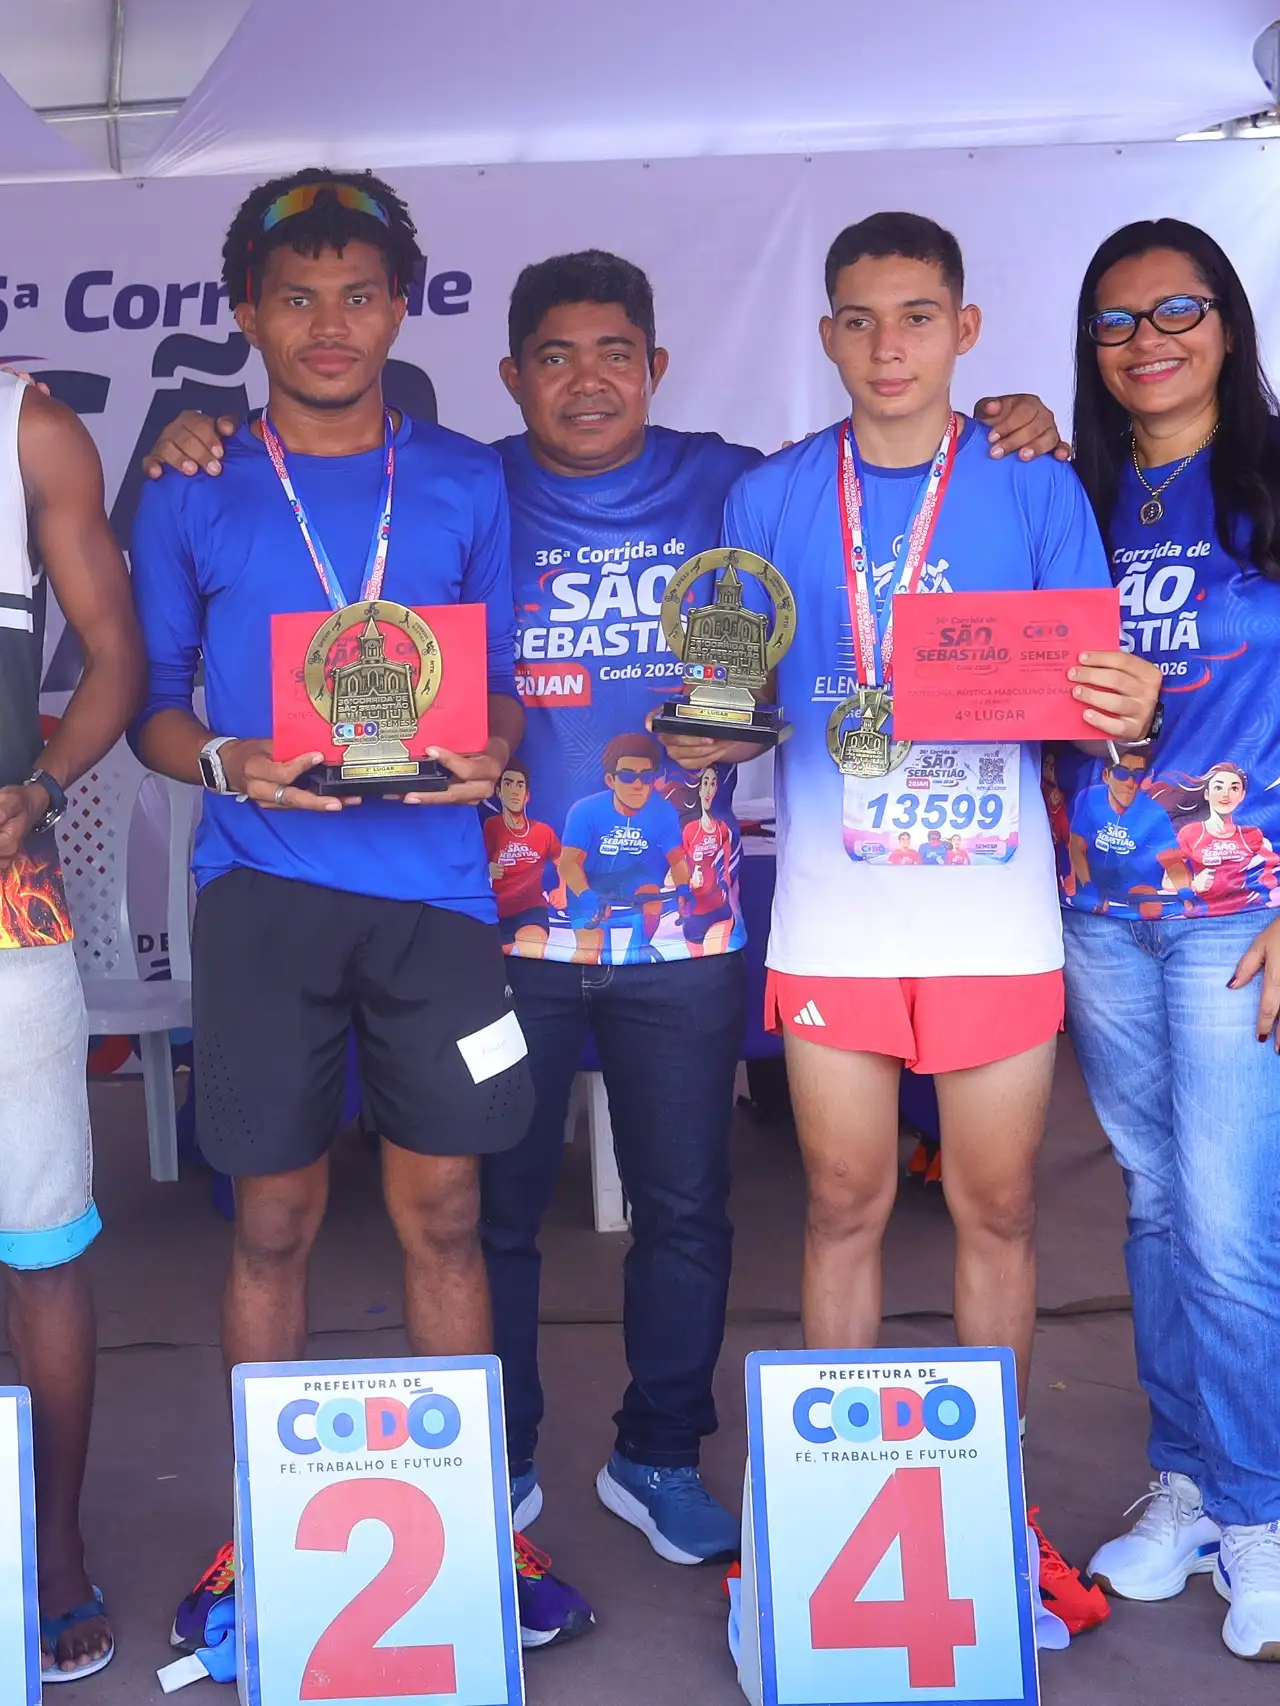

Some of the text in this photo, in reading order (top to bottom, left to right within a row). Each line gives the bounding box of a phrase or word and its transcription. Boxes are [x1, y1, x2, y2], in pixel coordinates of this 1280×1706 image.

[64, 270, 229, 333] Corr
[535, 538, 685, 567] 36ª Corrida de
[1113, 538, 1211, 564] Corrida de
[549, 561, 677, 622] SÃO
[1118, 560, 1196, 617] ÃO
[938, 624, 992, 647] SÃO
[916, 647, 1008, 662] SEBASTIÃO
[1020, 650, 1070, 660] SEMESP
[599, 662, 684, 681] Codó 2026
[353, 697, 394, 705] CORRIDA
[994, 687, 1044, 697] MASCULINO
[358, 702, 409, 712] SEBASTIÃO
[975, 710, 1026, 721] LUGAR
[379, 720, 417, 728] SEMESP
[921, 754, 955, 769] SÃO
[907, 766, 965, 778] SEBASTIÃO
[867, 793, 1003, 830] 13599
[819, 1368, 937, 1380] PREFEITURA DE
[304, 1378, 421, 1392] PREFEITURA DE
[792, 1378, 977, 1444] CODÓ
[277, 1387, 461, 1455] CODÓ
[795, 1448, 978, 1463] FÉ, TRABALHO E FUTURO
[280, 1457, 463, 1475] FÉ, TRABALHO E FUTURO
[808, 1466, 977, 1688] 4
[295, 1478, 457, 1701] 2
